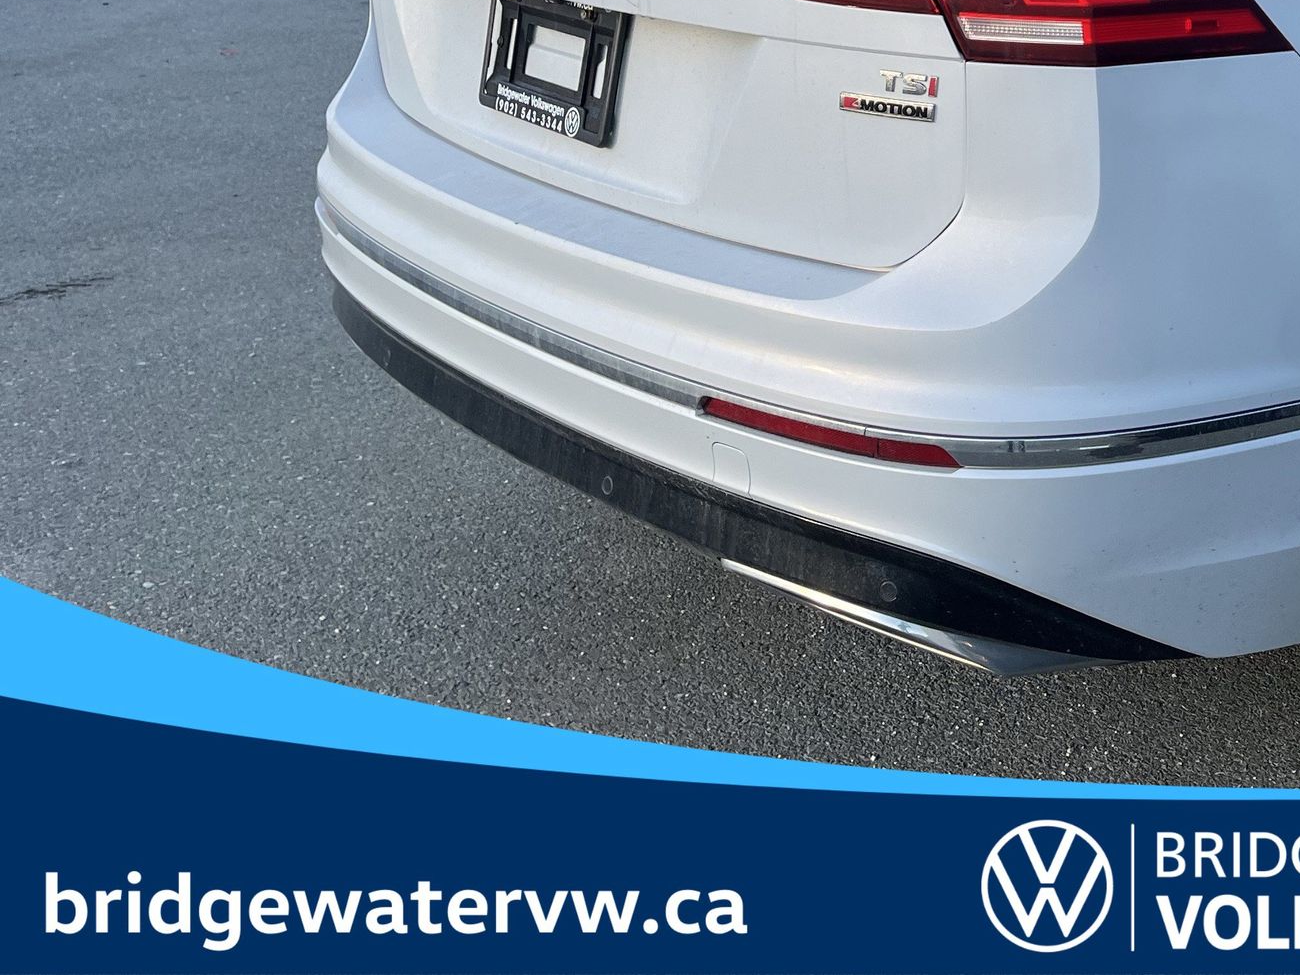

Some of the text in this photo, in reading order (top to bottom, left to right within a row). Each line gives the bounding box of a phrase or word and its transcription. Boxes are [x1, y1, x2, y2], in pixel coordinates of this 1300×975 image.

[497, 83, 565, 117] Bridgewater Volkswagen
[880, 69, 939, 97] TSI
[495, 96, 563, 133] (902) 543-3344
